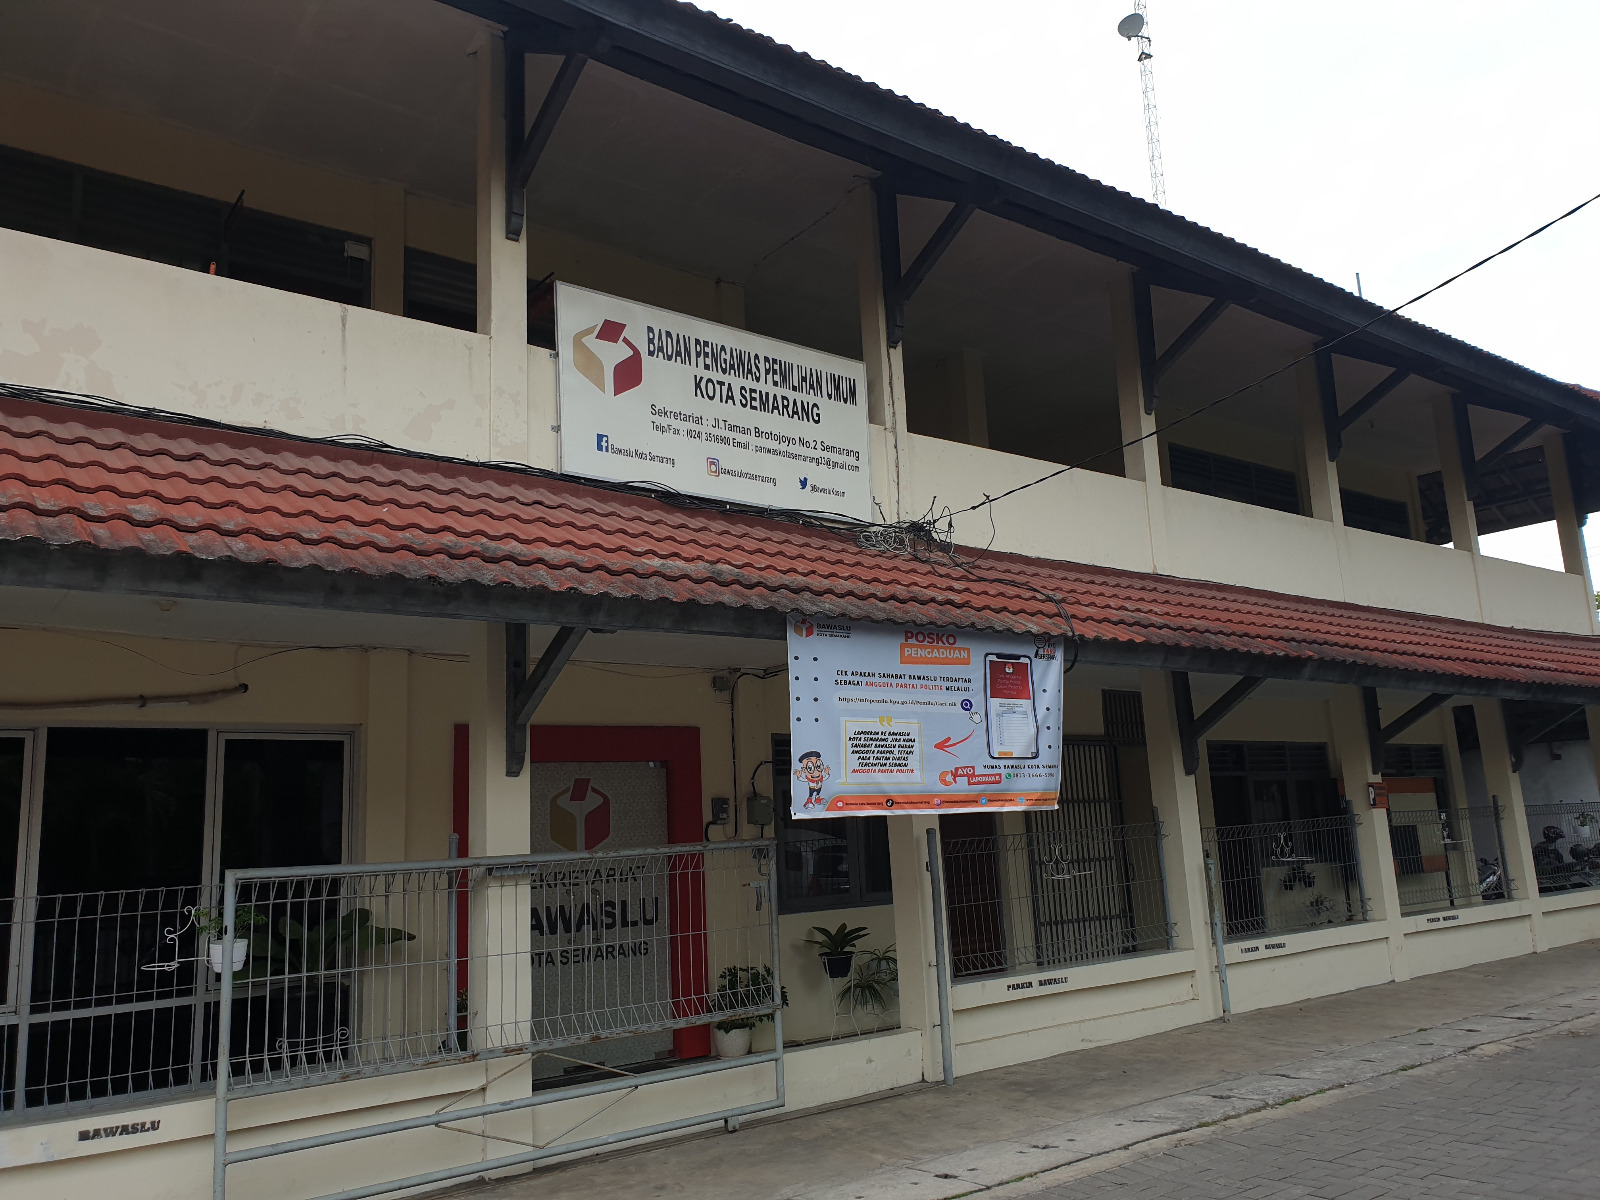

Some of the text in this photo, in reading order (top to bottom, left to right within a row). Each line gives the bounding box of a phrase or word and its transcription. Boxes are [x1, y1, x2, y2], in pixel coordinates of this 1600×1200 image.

[647, 325, 857, 406] BADAN PENGAWAS PEMILIHAN UMUM
[694, 374, 821, 424] KOTA SEMARANG
[650, 403, 704, 426] Sekretariat
[711, 417, 752, 437] Jl.Taman
[754, 426, 797, 447] Brotojoyo
[798, 436, 818, 450] No.2
[820, 440, 860, 461] Semarang
[732, 437, 750, 450] Email
[610, 443, 676, 468] Bawaslu Kota Semarang
[816, 622, 852, 632] BAWASLU
[904, 630, 958, 646] POSKO
[904, 647, 968, 659] PENGADUAN
[834, 679, 863, 687] SEBAGAI
[864, 680, 894, 689] ANGGOTA
[896, 682, 918, 690] PARTAI
[919, 683, 944, 691] POLITIK
[850, 670, 876, 678] APAKAH
[878, 672, 906, 680] SAHABAT
[908, 674, 938, 682] BAWASLU
[939, 675, 972, 683] TERDAFTAR
[957, 767, 974, 775] AYO
[531, 865, 646, 889] EKRETARIAT
[531, 897, 659, 936] AWASLU
[559, 941, 649, 965] SEMARANG
[1006, 976, 1069, 991] PARKIR BAWASLU
[78, 1119, 161, 1141] BAWASLU
